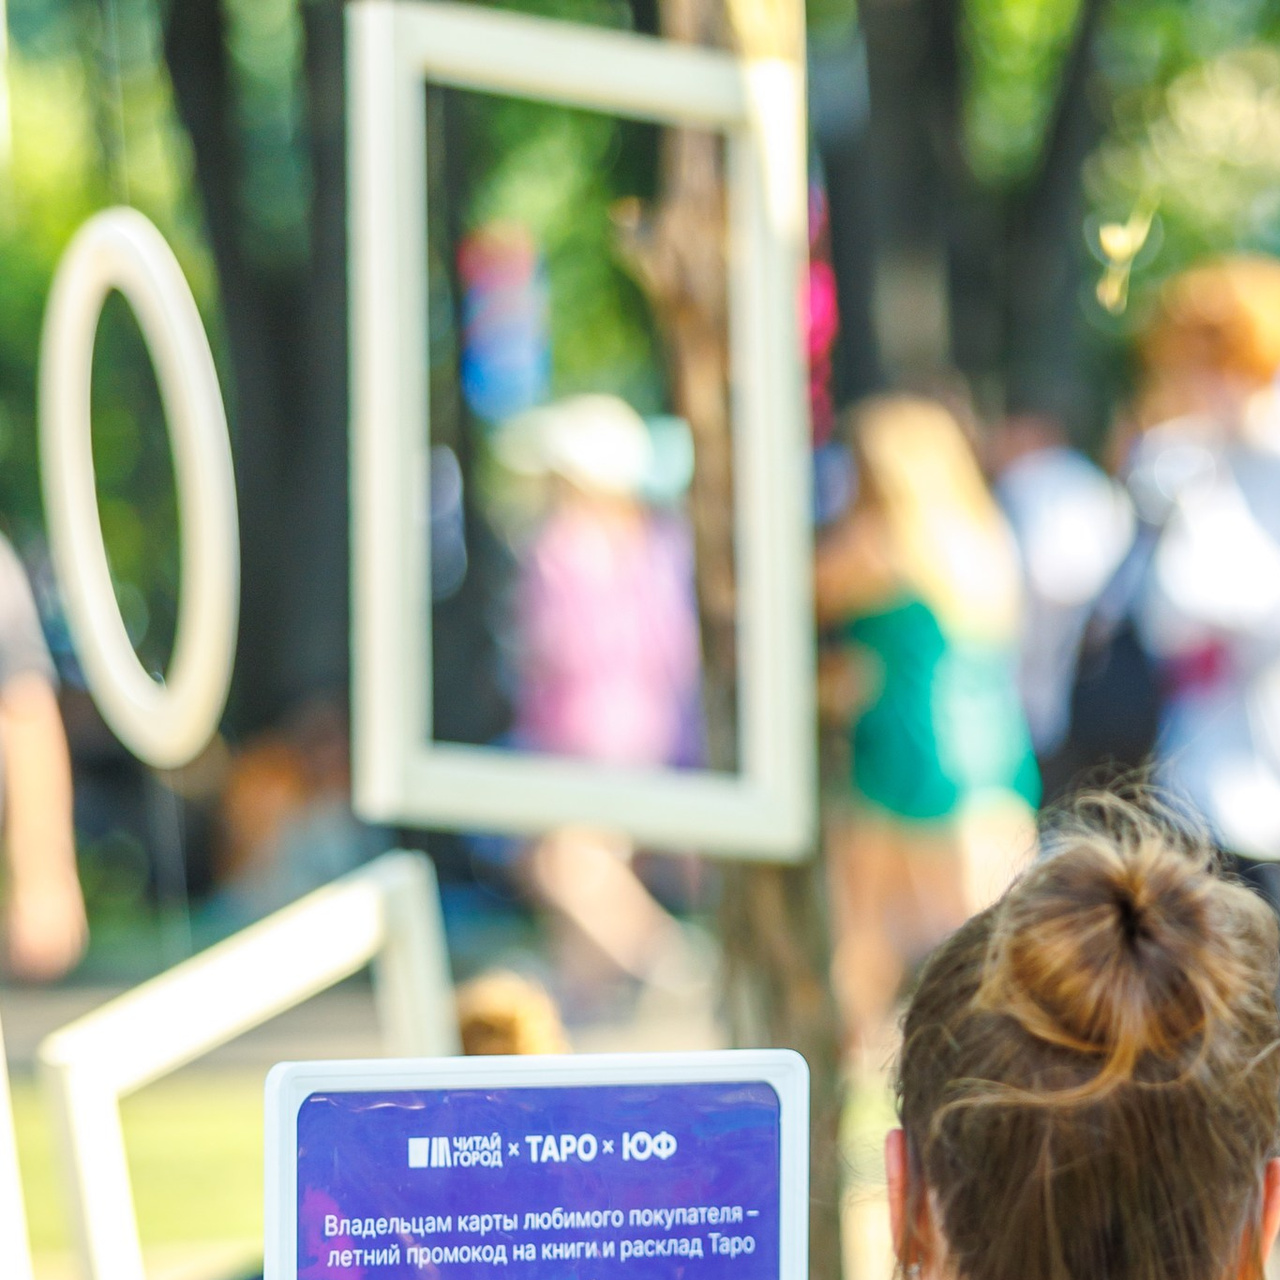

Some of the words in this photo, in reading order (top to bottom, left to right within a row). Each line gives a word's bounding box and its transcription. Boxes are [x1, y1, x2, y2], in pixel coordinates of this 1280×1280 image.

[453, 1132, 502, 1151] ЧИТАЙ
[524, 1133, 598, 1163] ТАРО
[621, 1131, 677, 1161] ЮФ
[453, 1151, 503, 1168] ГОРОД
[324, 1214, 452, 1239] Владельцам
[457, 1212, 518, 1236] карты
[523, 1207, 625, 1231] любимого
[629, 1205, 743, 1232] покупателя
[327, 1243, 400, 1268] летний
[406, 1244, 508, 1269] промокод
[513, 1242, 537, 1262] на
[541, 1240, 598, 1260] книги
[602, 1241, 615, 1258] и
[620, 1236, 704, 1263] расклад
[707, 1232, 756, 1260] Таро
